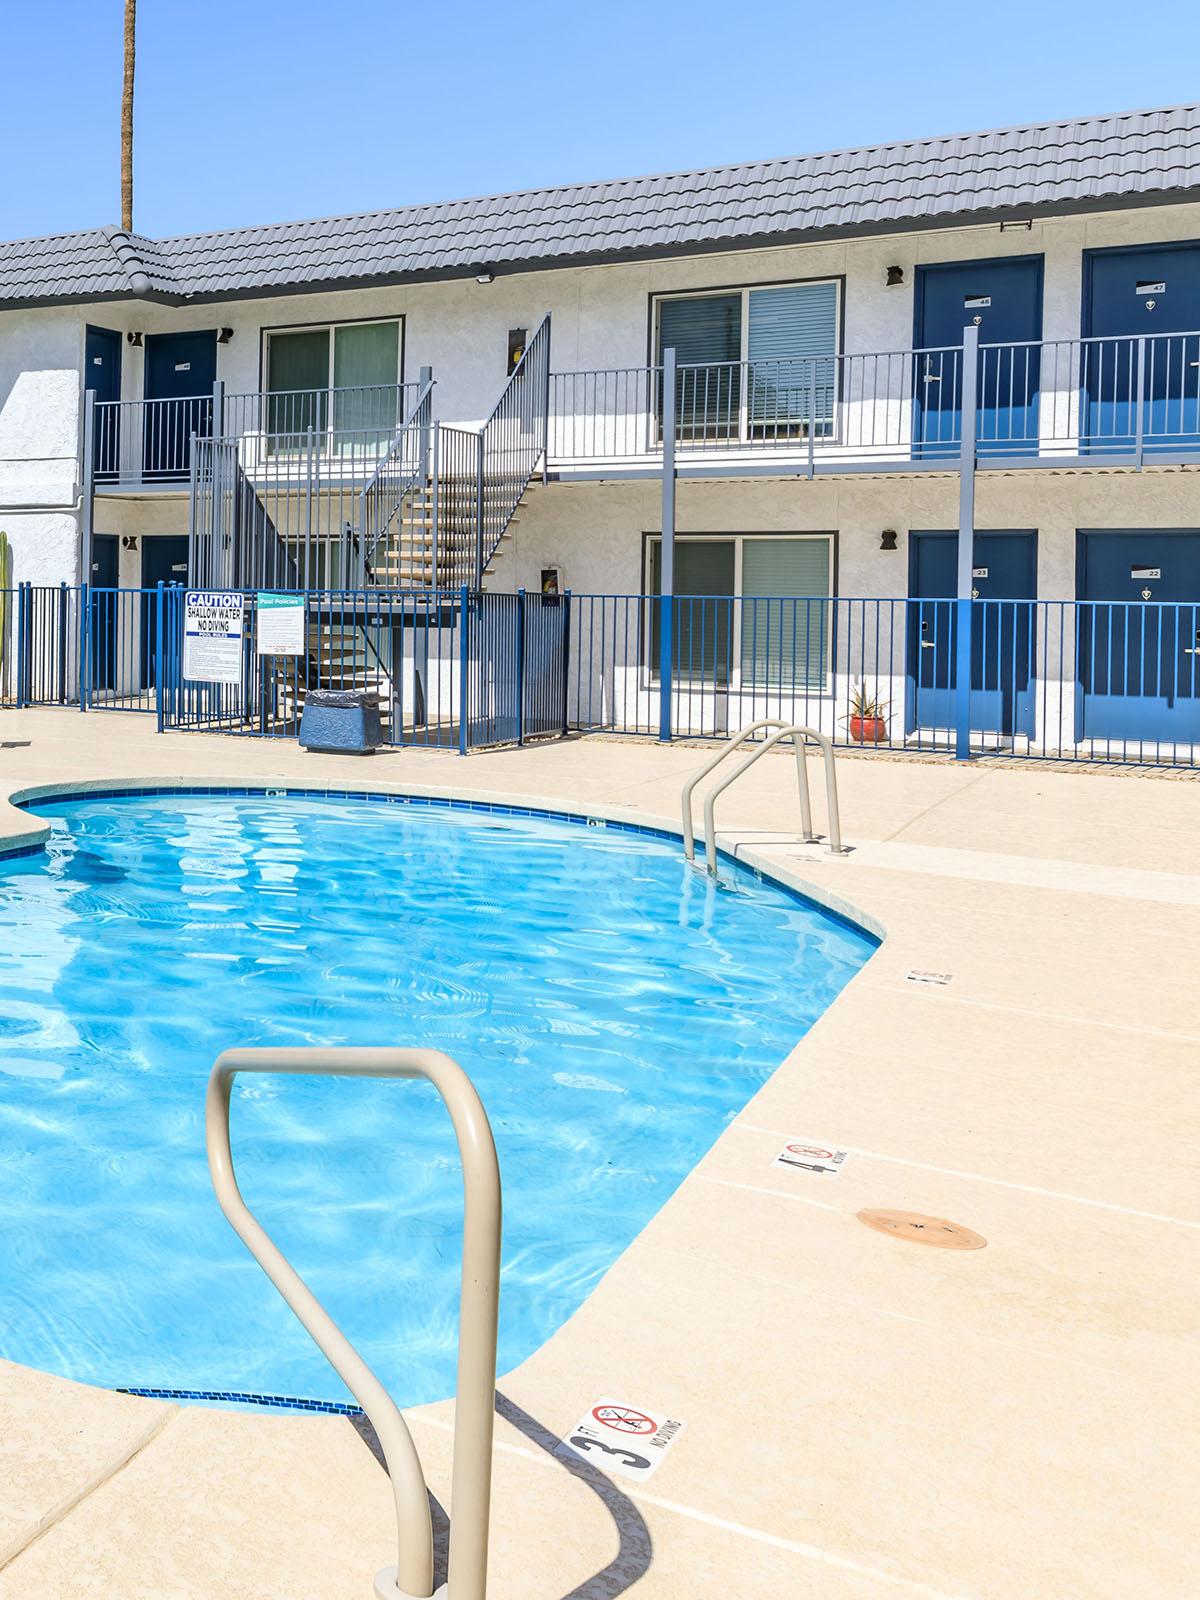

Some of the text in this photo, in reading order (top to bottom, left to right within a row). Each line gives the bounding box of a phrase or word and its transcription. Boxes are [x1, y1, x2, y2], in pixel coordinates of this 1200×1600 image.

[188, 594, 240, 607] CAUTION
[187, 607, 241, 620] SHALLOW WATER
[197, 620, 229, 632] NO DIVING
[778, 1158, 837, 1173] 4
[569, 1436, 651, 1469] 3
